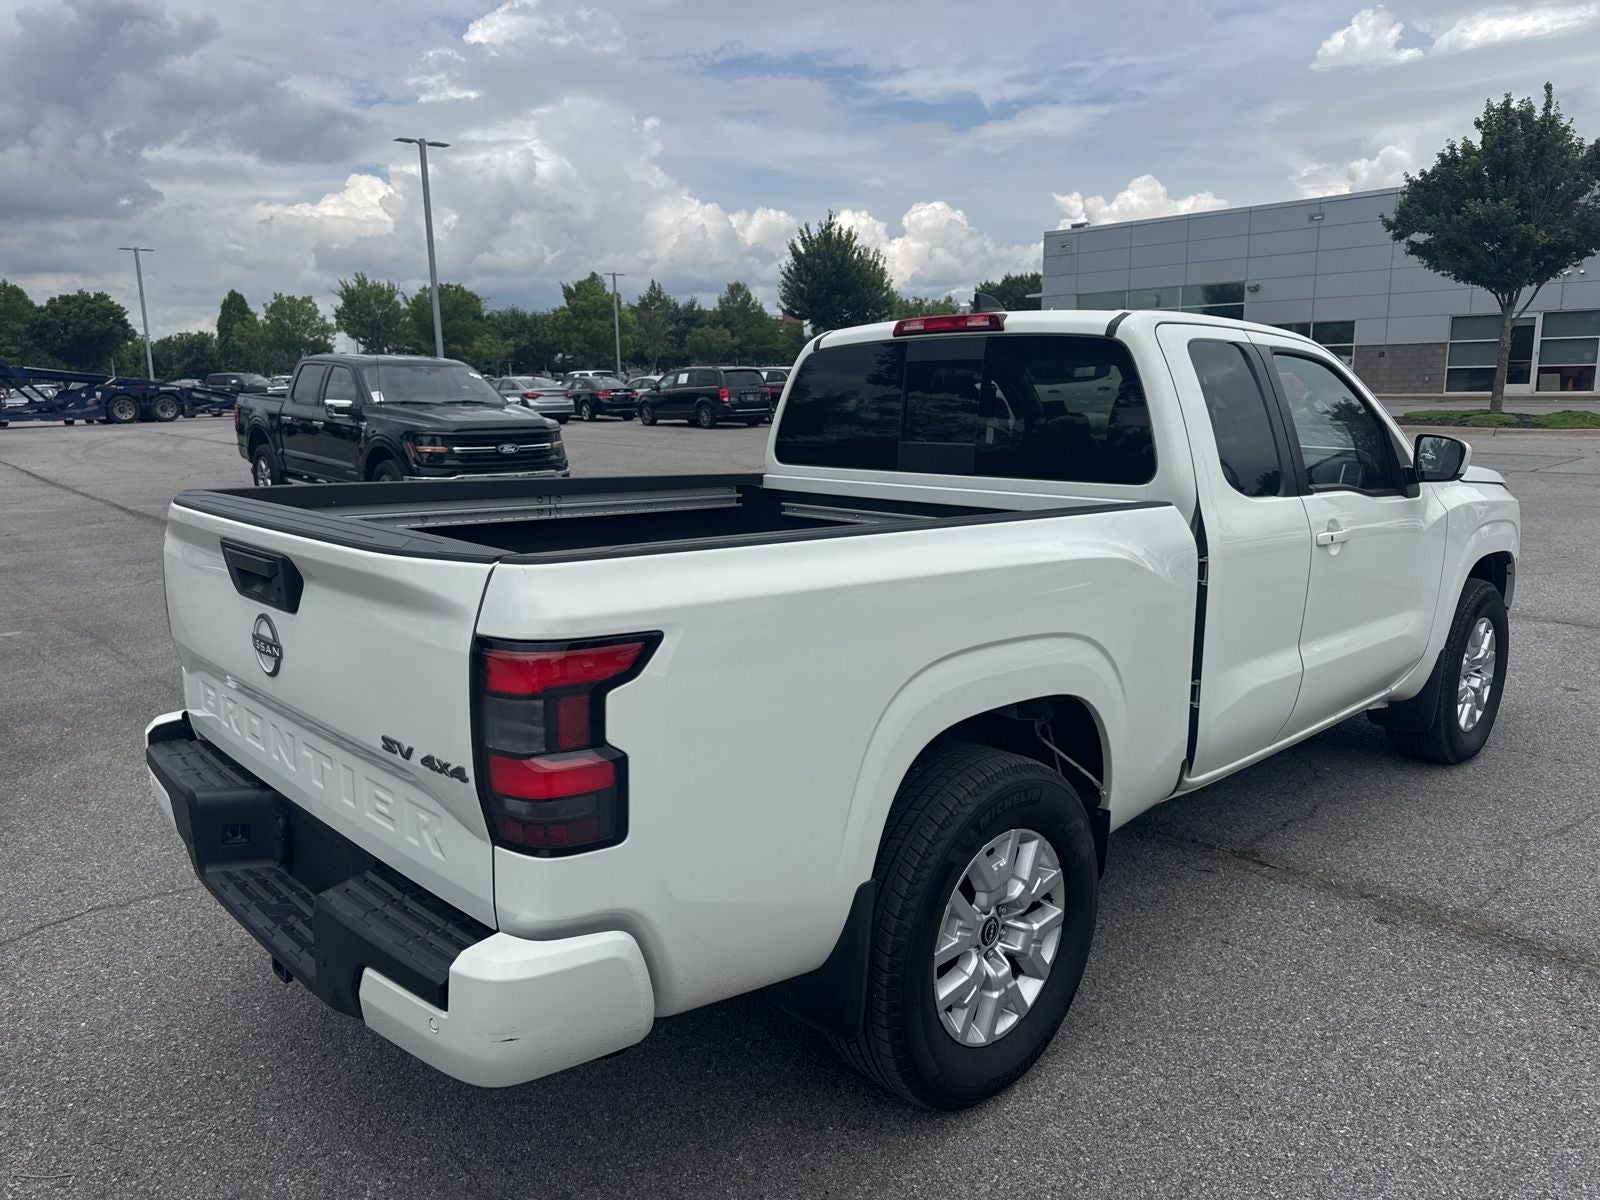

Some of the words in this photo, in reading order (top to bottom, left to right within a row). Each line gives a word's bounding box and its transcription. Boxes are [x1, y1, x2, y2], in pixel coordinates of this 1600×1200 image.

[254, 638, 280, 657] SSAN
[381, 735, 414, 760] SV
[200, 680, 446, 861] FRONTIER
[980, 788, 1042, 828] MICHELIN
